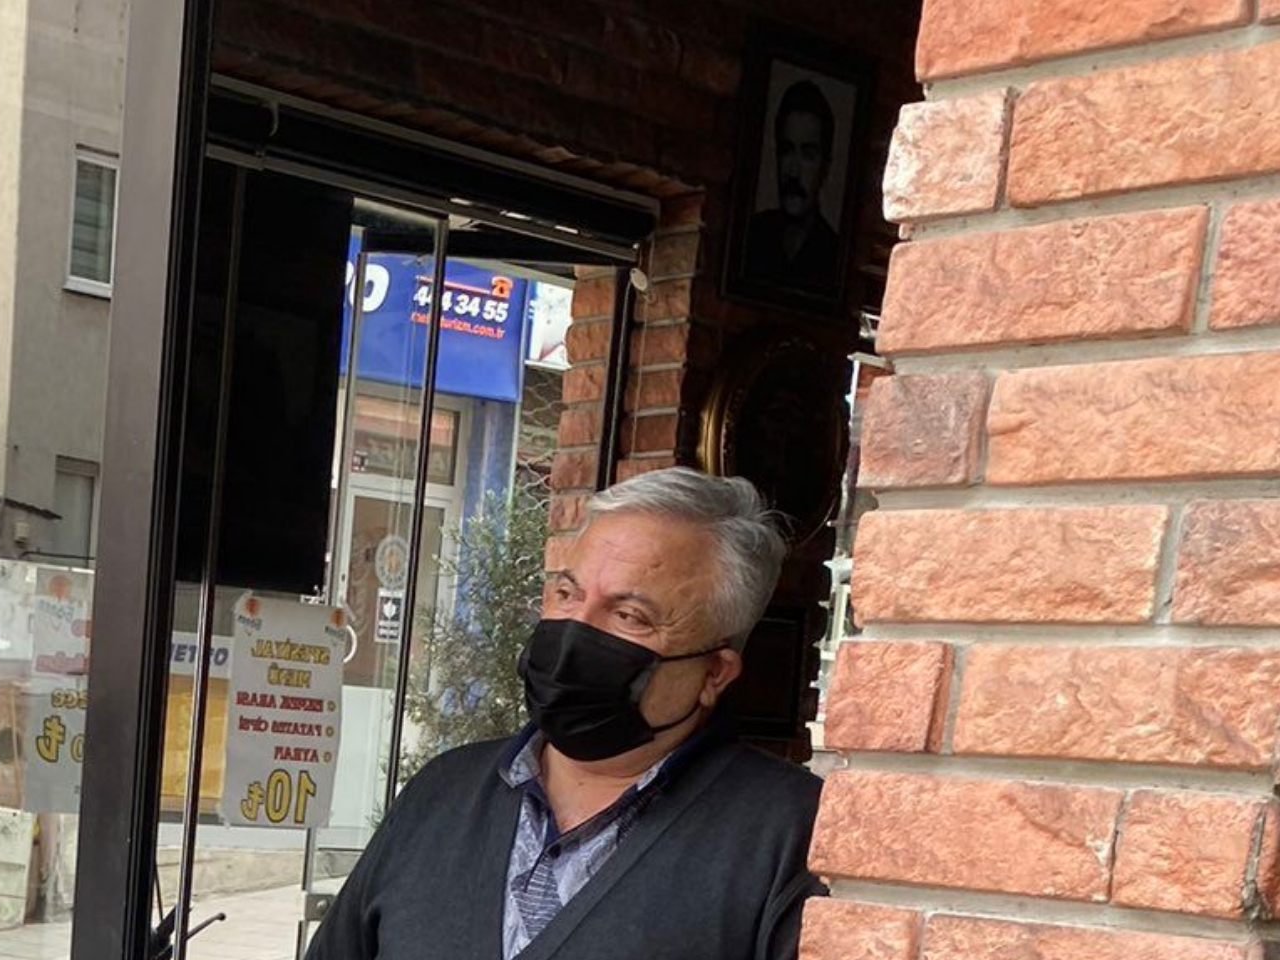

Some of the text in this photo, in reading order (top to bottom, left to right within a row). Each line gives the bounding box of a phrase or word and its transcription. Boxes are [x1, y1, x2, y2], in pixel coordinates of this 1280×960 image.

[413, 286, 509, 322] 44 34 55
